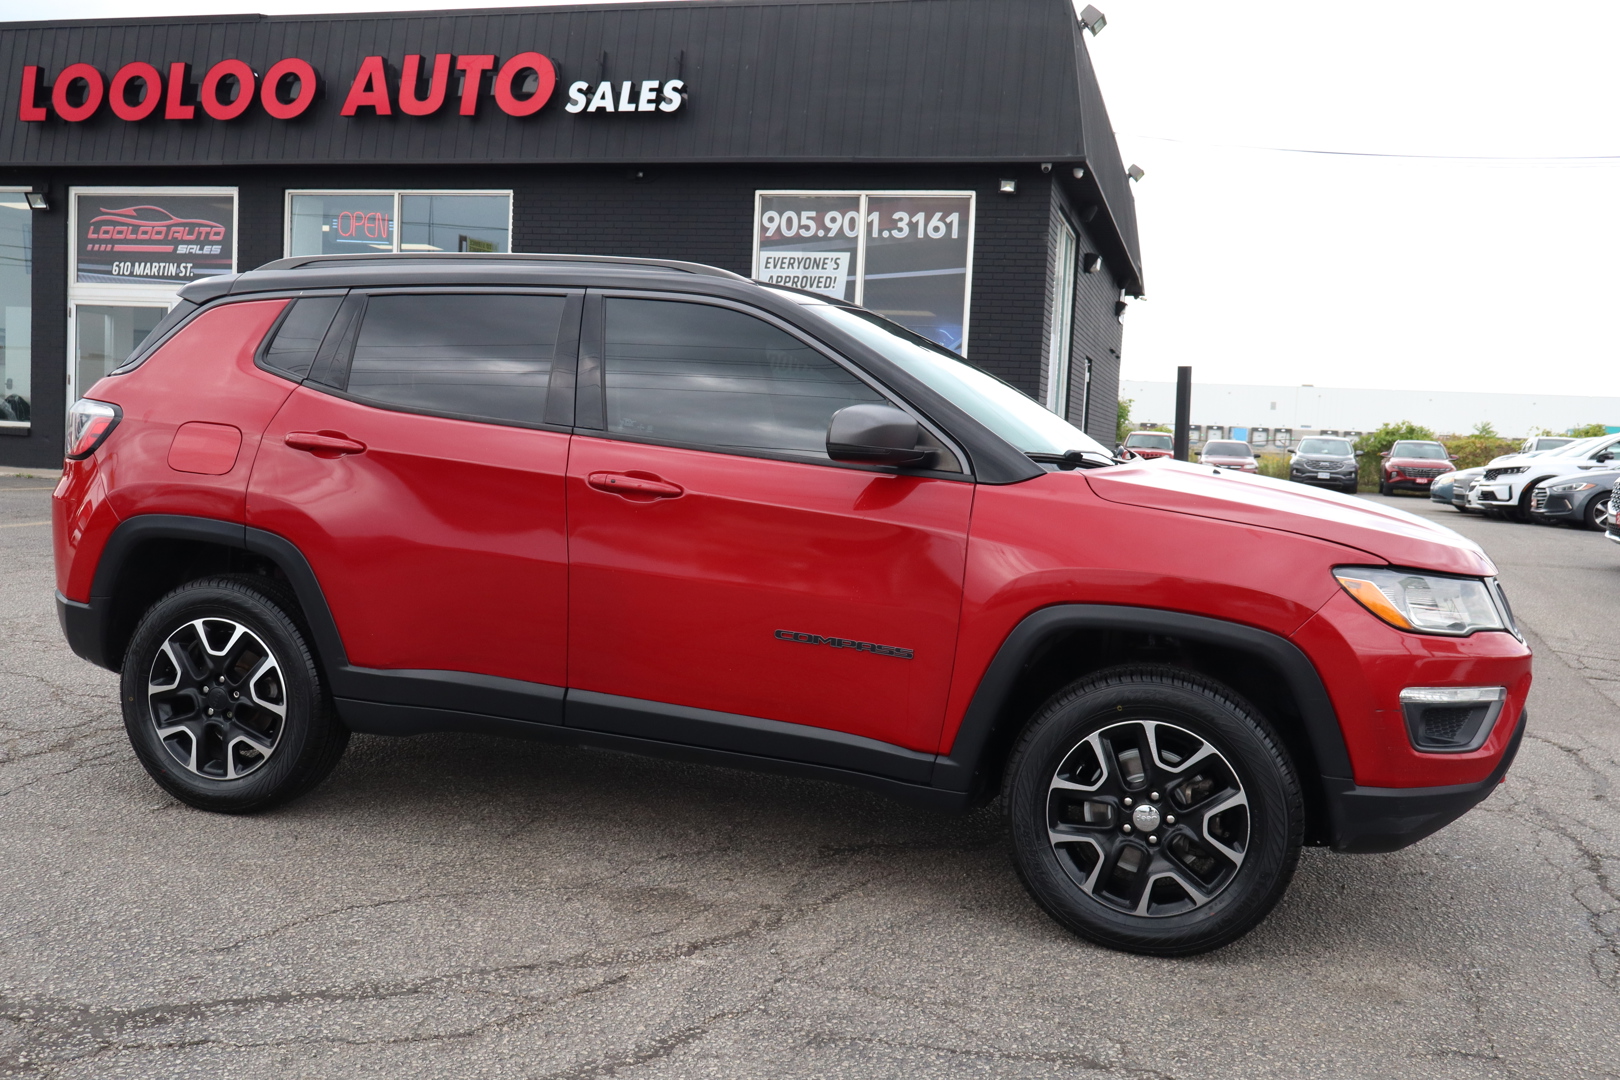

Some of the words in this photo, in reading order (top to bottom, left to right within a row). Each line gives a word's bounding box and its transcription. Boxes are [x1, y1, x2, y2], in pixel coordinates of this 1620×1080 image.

[19, 57, 317, 122] LOOLOO
[340, 51, 556, 117] AUTO
[565, 79, 685, 113] SALES
[87, 226, 167, 240] LOOLOO
[168, 227, 226, 240] AUTO
[338, 211, 389, 238] OPEN
[762, 210, 960, 239] 905.901.3161
[176, 245, 222, 254] SALES
[112, 261, 132, 275] 610
[133, 262, 177, 276] MARTIN
[178, 264, 194, 277] ST.
[764, 256, 841, 270] EVERYONE'S
[774, 629, 914, 659] COMPASS
